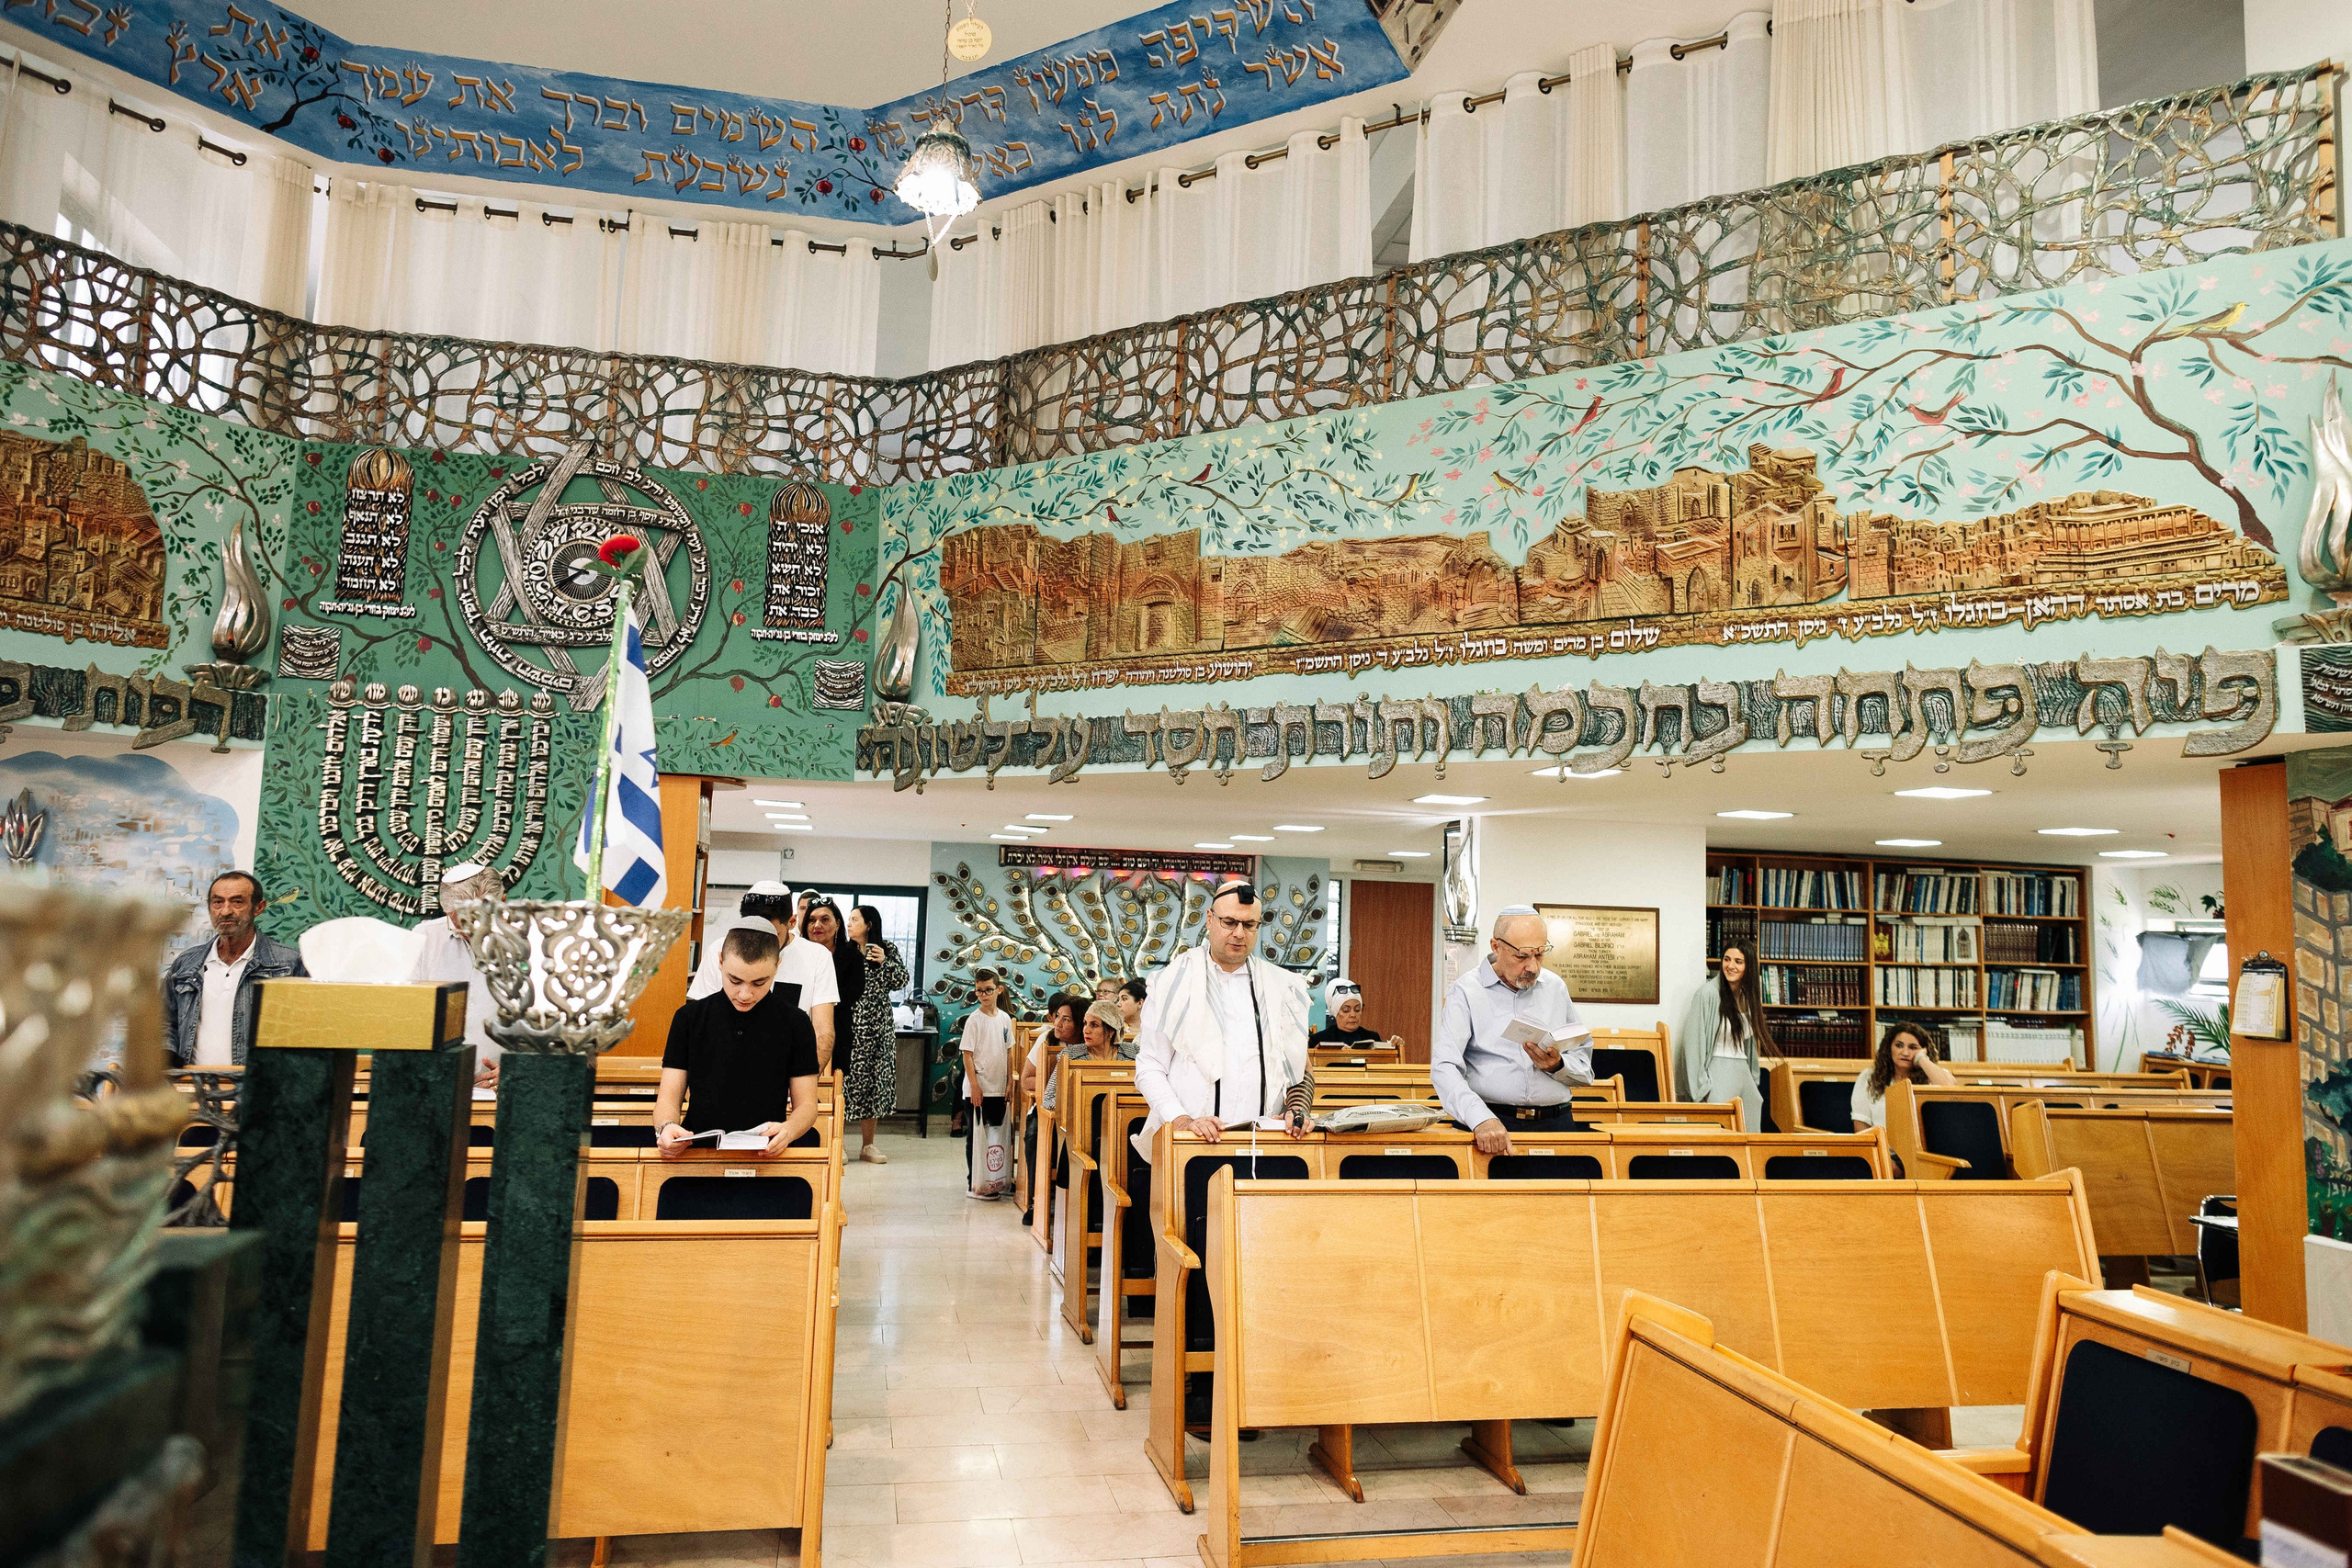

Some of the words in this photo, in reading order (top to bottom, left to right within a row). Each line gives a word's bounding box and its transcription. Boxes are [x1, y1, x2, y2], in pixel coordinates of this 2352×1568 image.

[209, 3, 291, 60] את
[164, 18, 265, 110] ארץ
[1241, 37, 1345, 91] אשר
[340, 59, 434, 107] עמך
[448, 71, 516, 113] את
[1012, 47, 1120, 116] ממעון
[1149, 66, 1227, 131] נתת
[541, 85, 649, 134] וברך
[671, 101, 820, 153] השמים
[1058, 96, 1119, 152] לנו
[394, 114, 584, 176] לאבותינו
[865, 118, 908, 161] מן
[634, 143, 790, 202] נשבעת
[510, 462, 546, 485] לכל
[387, 487, 405, 503] לא
[386, 508, 403, 525] לא
[775, 521, 787, 532] ה'
[380, 530, 401, 547] לא
[548, 524, 568, 548] 11
[571, 521, 597, 540] 12
[796, 522, 824, 535] אנכי
[532, 539, 553, 561] 10
[773, 541, 798, 553] יהיה
[806, 542, 823, 555] לא
[381, 551, 399, 568] לא
[772, 563, 800, 575] תשא
[804, 561, 821, 577] לא
[528, 560, 548, 581] 9
[379, 575, 396, 592] לא
[536, 581, 554, 607] 8
[772, 583, 790, 595] את
[795, 585, 820, 597] זכור
[2195, 581, 2261, 604] מרים
[552, 596, 570, 616] 7
[594, 598, 614, 617] 5
[2096, 592, 2150, 613] אסתר
[2155, 590, 2185, 608] בת
[16, 610, 67, 633] סולטנה
[571, 604, 593, 623] 6
[768, 605, 788, 617] את
[791, 606, 820, 618] כבד
[70, 622, 85, 638] בן
[89, 615, 137, 643] אליהו
[1610, 618, 1662, 649] שלום
[1797, 618, 1827, 644] ניסן
[1459, 631, 1509, 660] בוזגלו
[1513, 637, 1549, 655] ומשה
[1554, 635, 1586, 653] מרים
[1591, 635, 1605, 656] בן
[1158, 660, 1193, 682] סולטנה
[1207, 660, 1253, 680] יהושוע
[1348, 651, 1371, 671] ניסן
[2316, 662, 2352, 678] שמת
[1125, 669, 1156, 683] ויהודה
[1194, 665, 1206, 682] בן
[1773, 657, 2040, 775] פתחה
[2077, 645, 2277, 768] פיה
[1018, 692, 1091, 785] על
[1472, 675, 1747, 782] בחכמה
